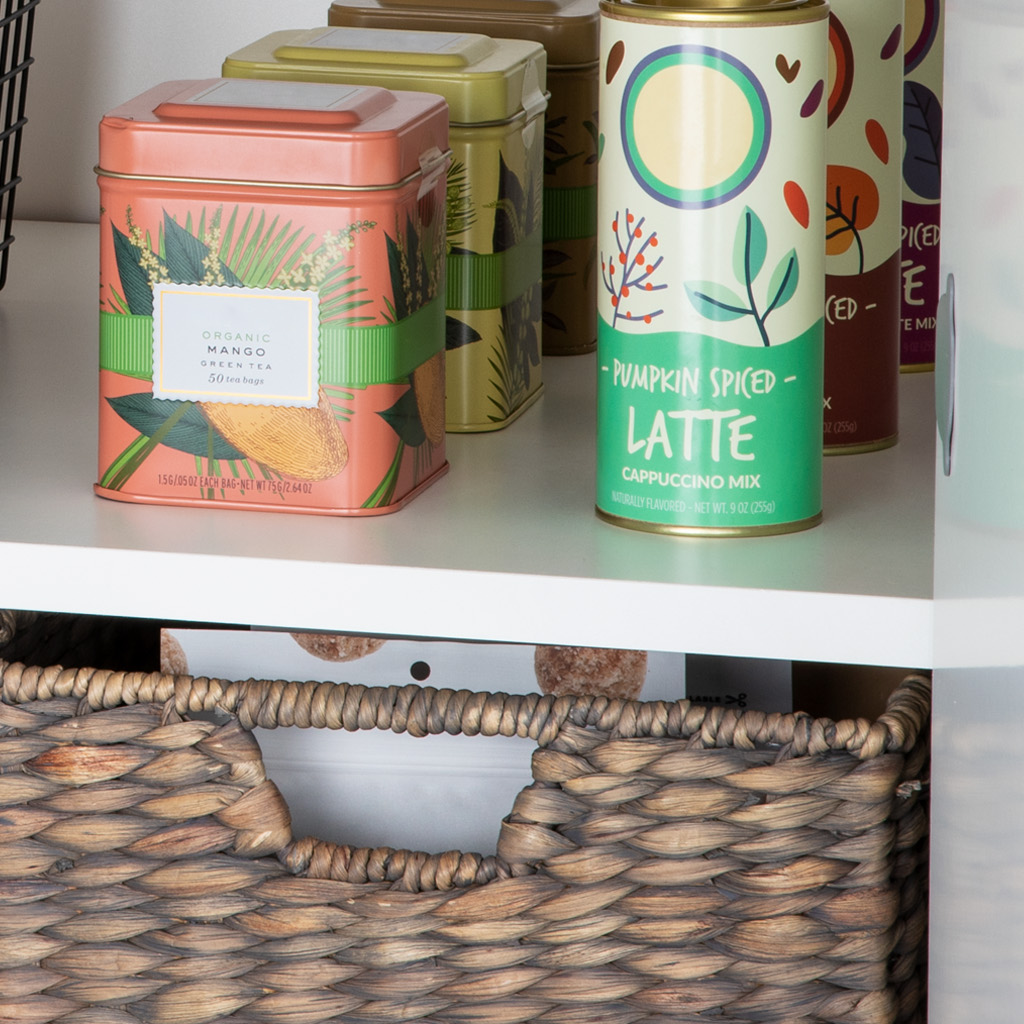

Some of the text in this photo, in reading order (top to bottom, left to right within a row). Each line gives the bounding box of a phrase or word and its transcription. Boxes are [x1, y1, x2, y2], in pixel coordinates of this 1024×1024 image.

[202, 330, 270, 343] ORGANIC
[207, 345, 266, 357] MANGO
[200, 360, 272, 370] GREEN TEA
[208, 373, 265, 386] 50 tea bags
[613, 358, 777, 399] PUMPKIN SPICED
[627, 406, 757, 462] LATTE
[199, 477, 219, 489] EACH
[256, 480, 266, 492] WT
[622, 467, 761, 489] CAPPUCCINO MIX
[611, 490, 645, 508] NATURALLY
[646, 497, 686, 512] FLAVORED
[694, 502, 710, 513] NET
[712, 502, 728, 514] WT.
[729, 503, 735, 514] 9
[737, 503, 748, 514] OZ
[750, 500, 776, 515] (255g)
